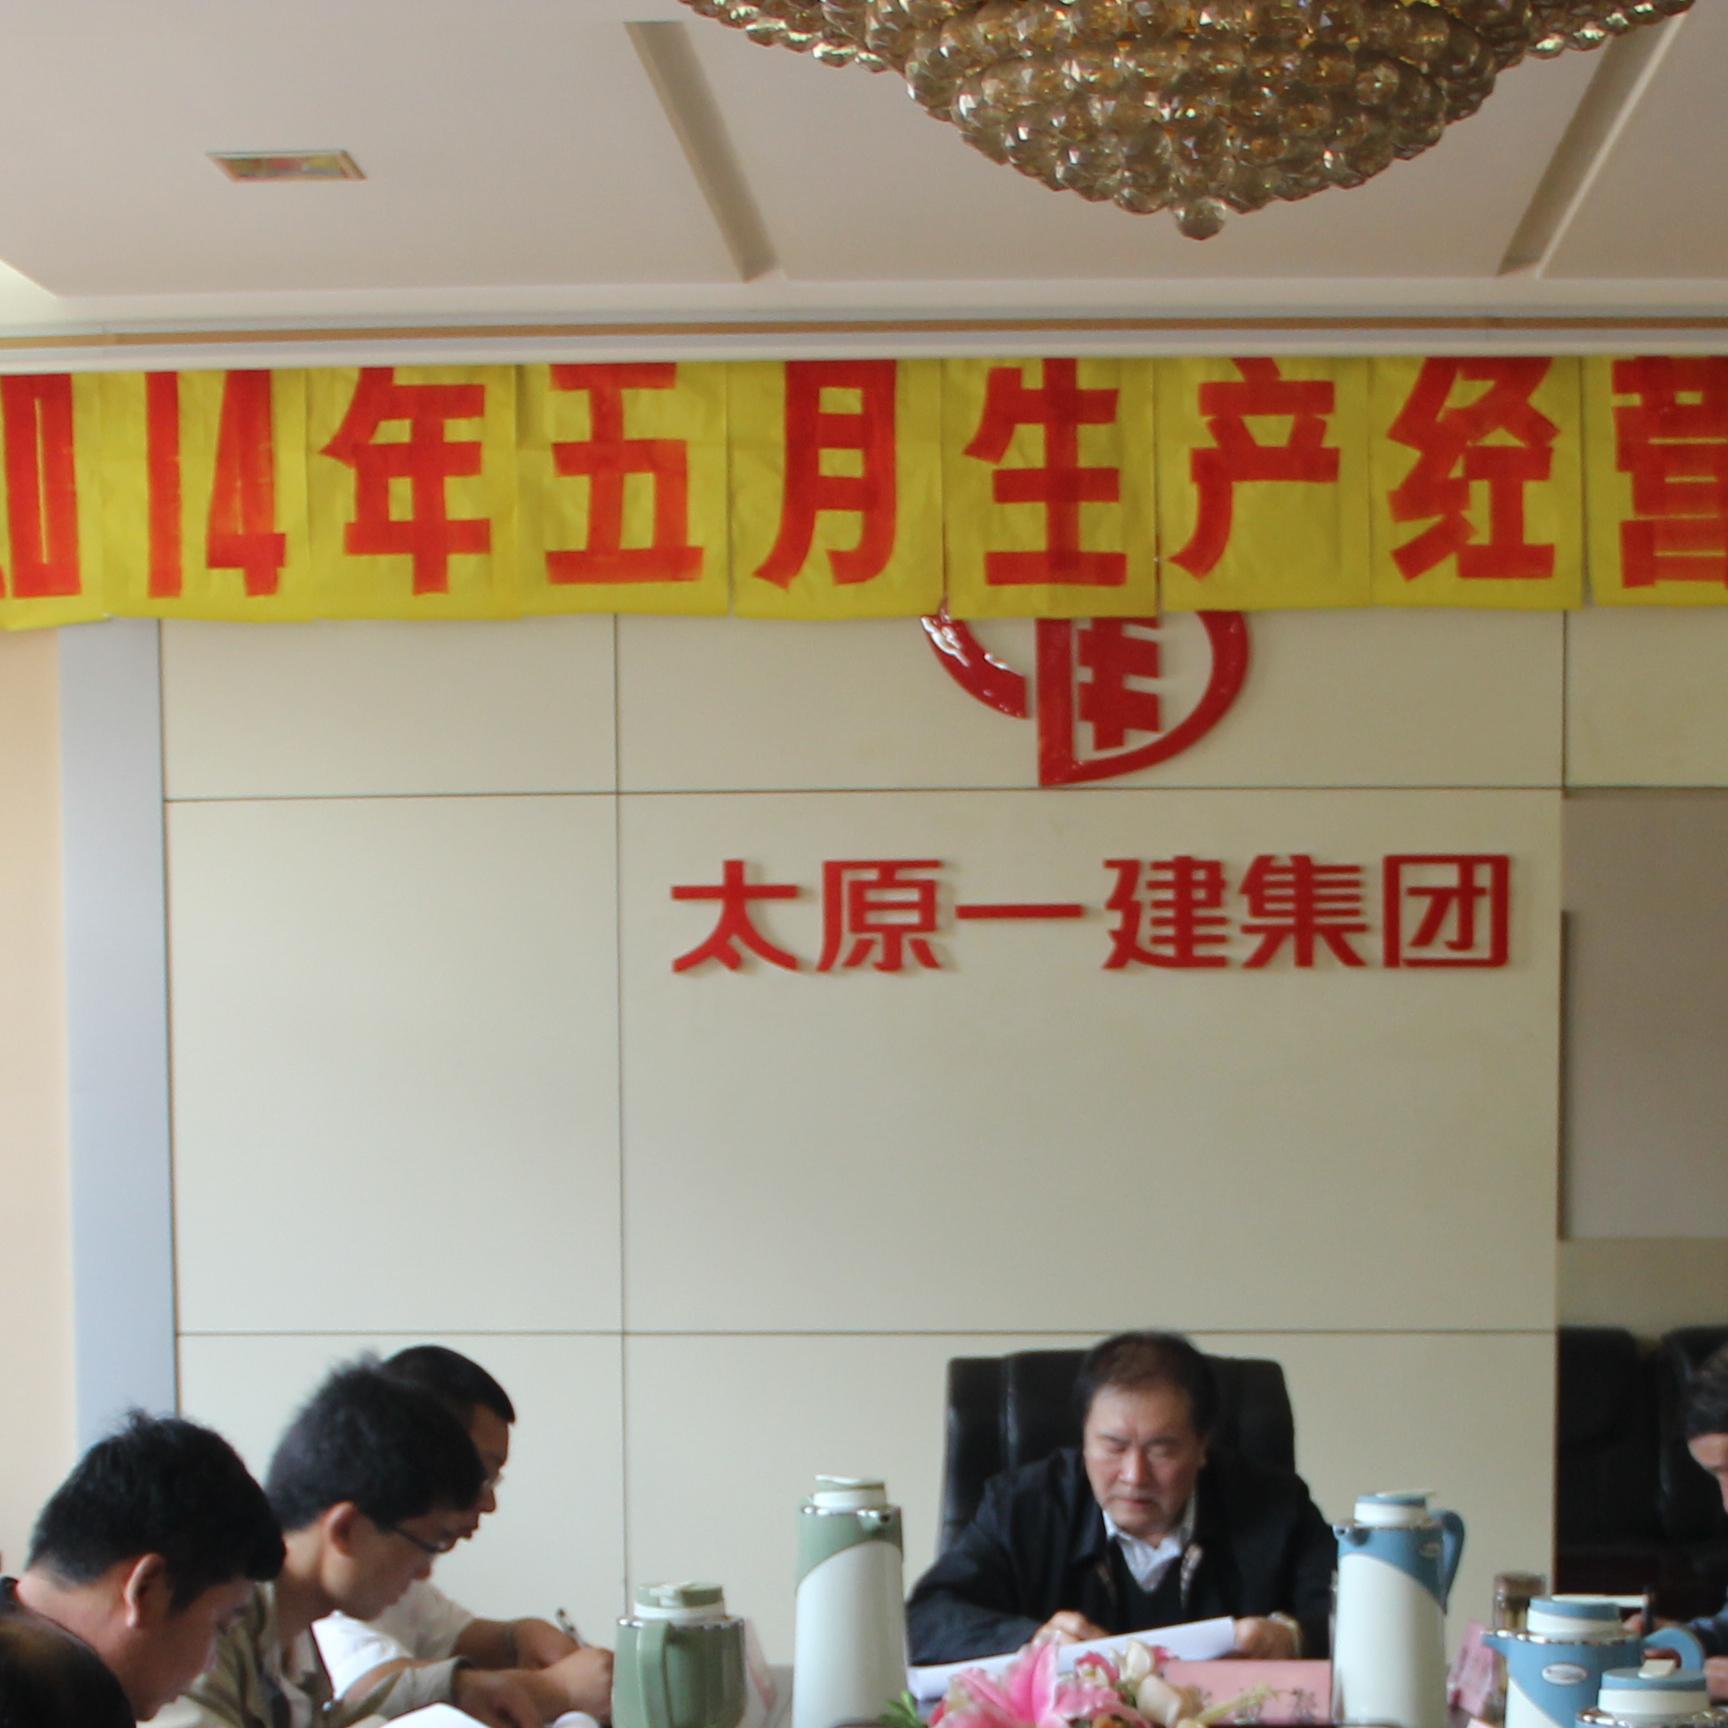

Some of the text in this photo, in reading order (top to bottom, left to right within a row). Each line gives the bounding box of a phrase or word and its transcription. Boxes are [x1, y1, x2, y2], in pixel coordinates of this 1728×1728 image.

[671, 853, 1510, 973] 太原一建集团
